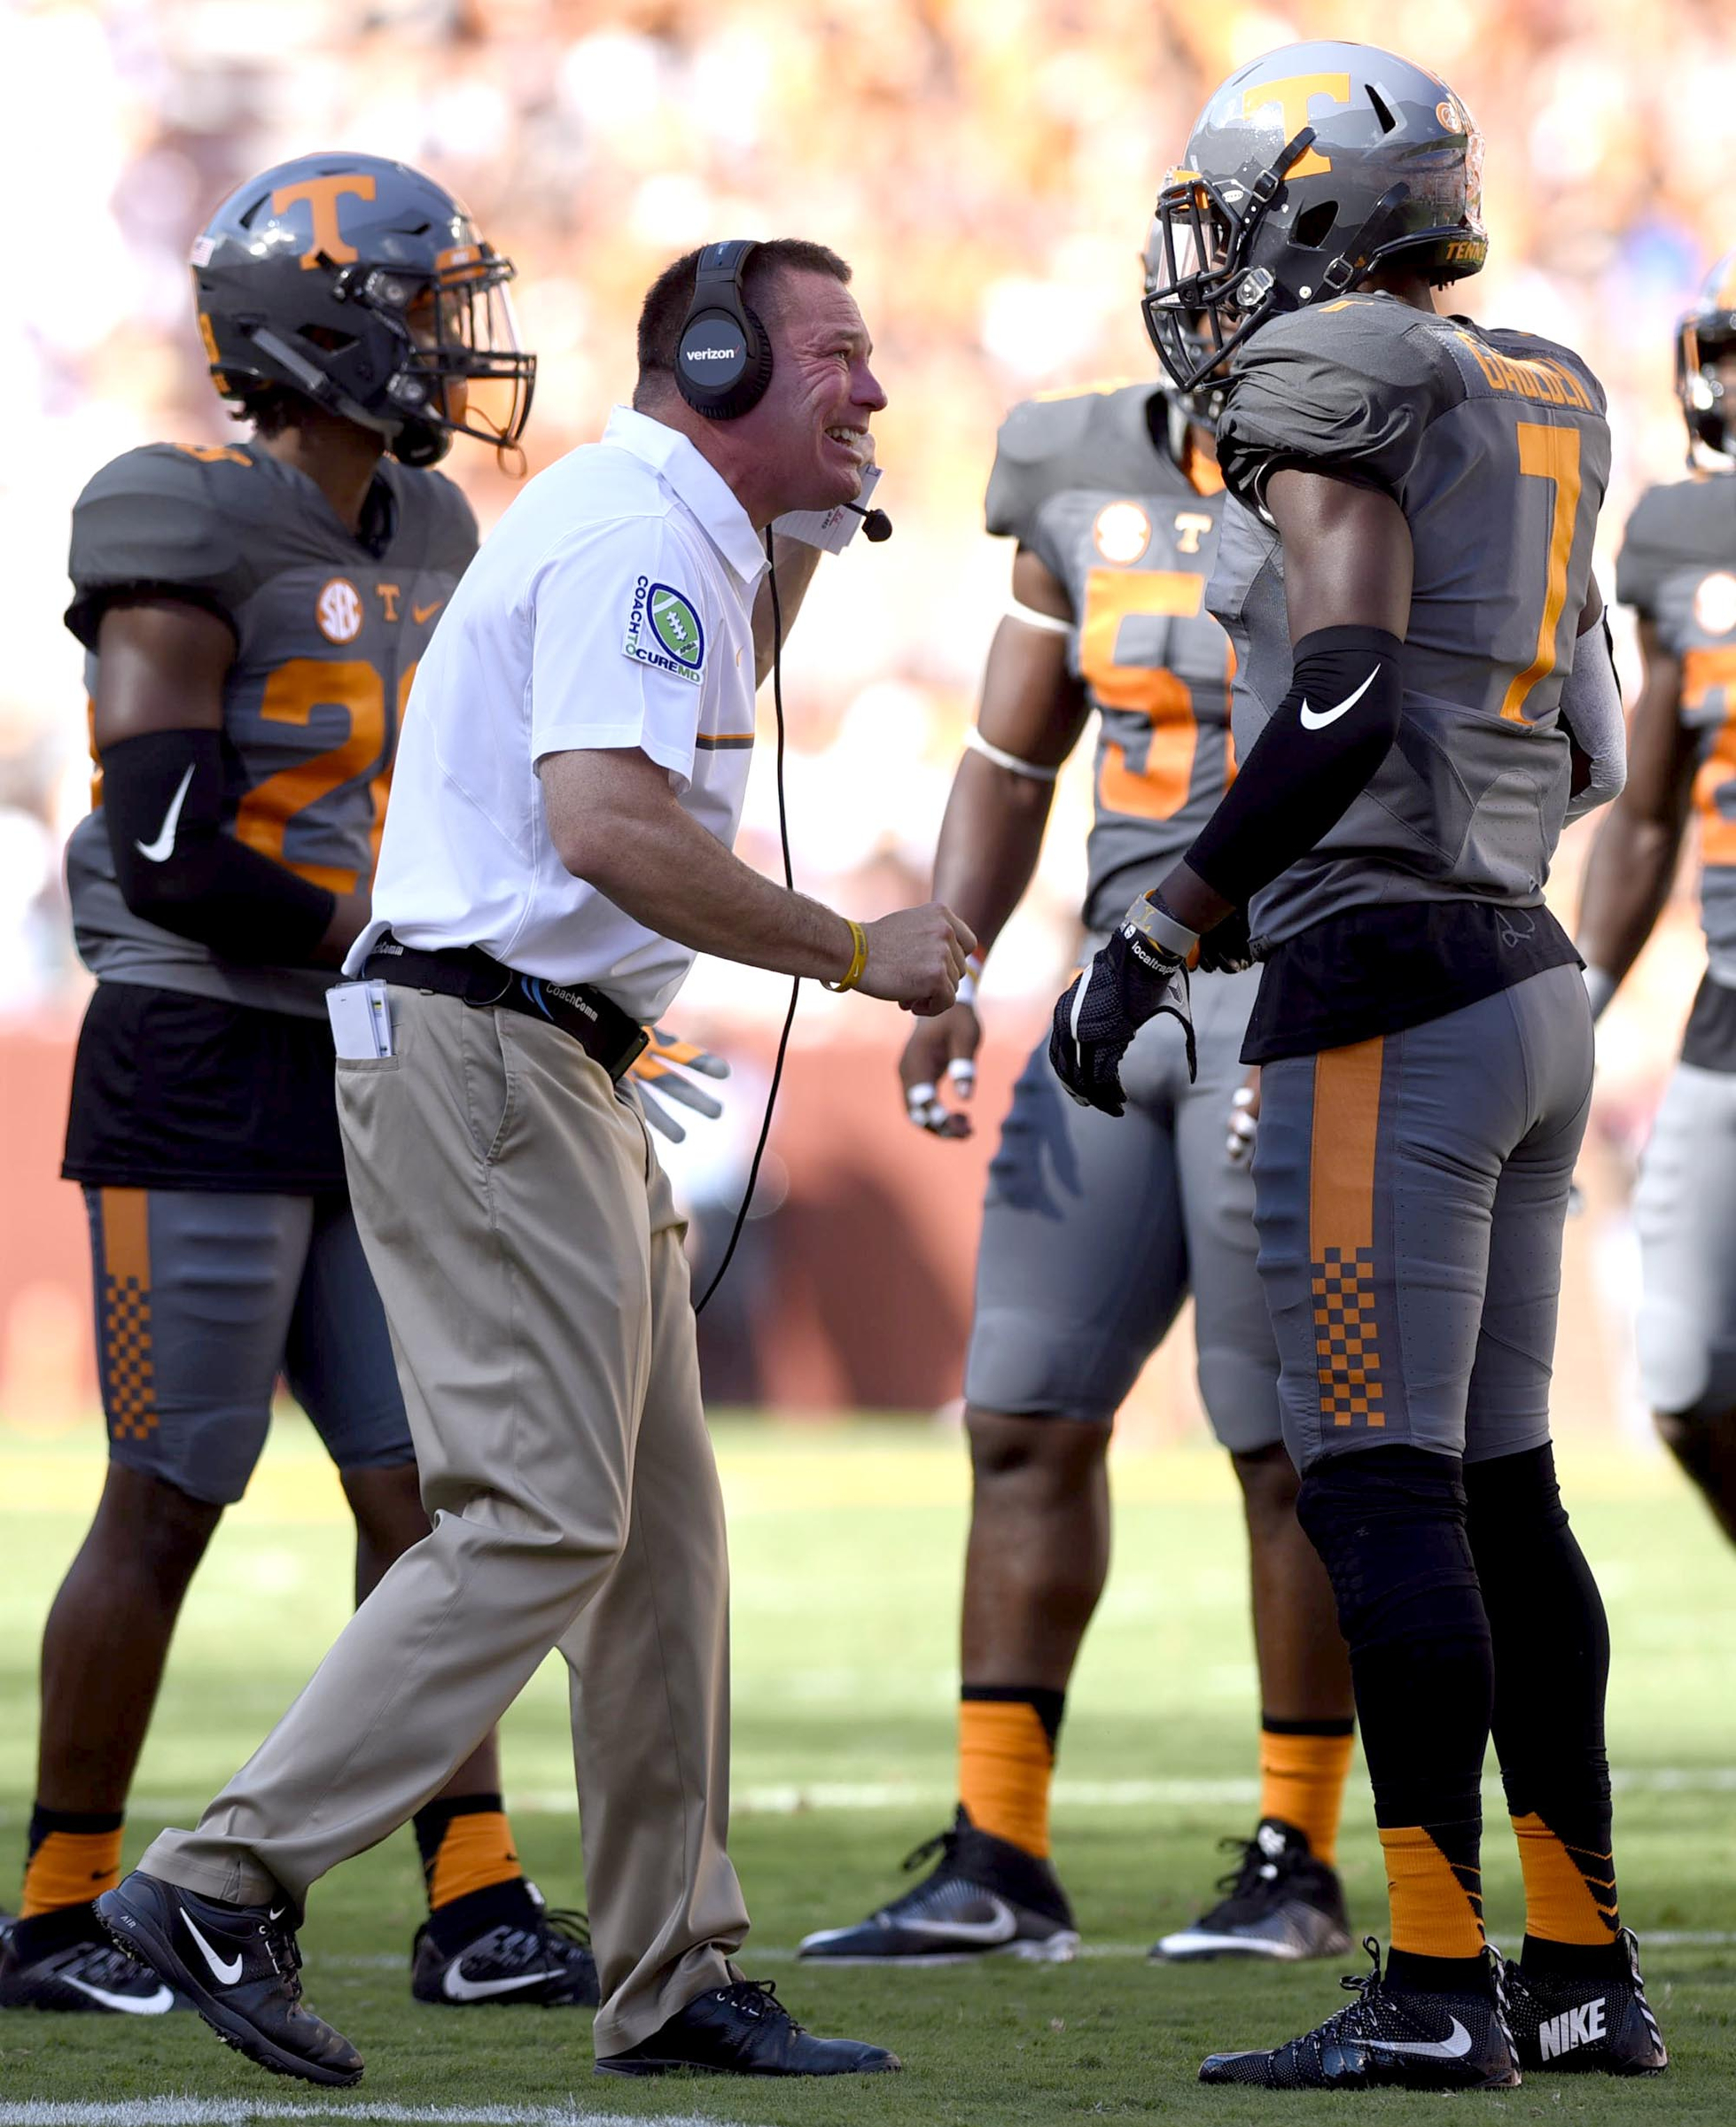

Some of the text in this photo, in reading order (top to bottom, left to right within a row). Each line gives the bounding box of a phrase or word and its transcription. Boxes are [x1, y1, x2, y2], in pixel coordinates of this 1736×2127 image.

[1242, 73, 1351, 181] T
[271, 175, 376, 269] T
[687, 347, 735, 361] verizon
[1500, 422, 1582, 726] 7
[377, 583, 401, 622] T
[546, 982, 598, 1022] CoachComm
[120, 1915, 136, 1928] AIR
[1539, 1997, 1607, 2062] NIKE
